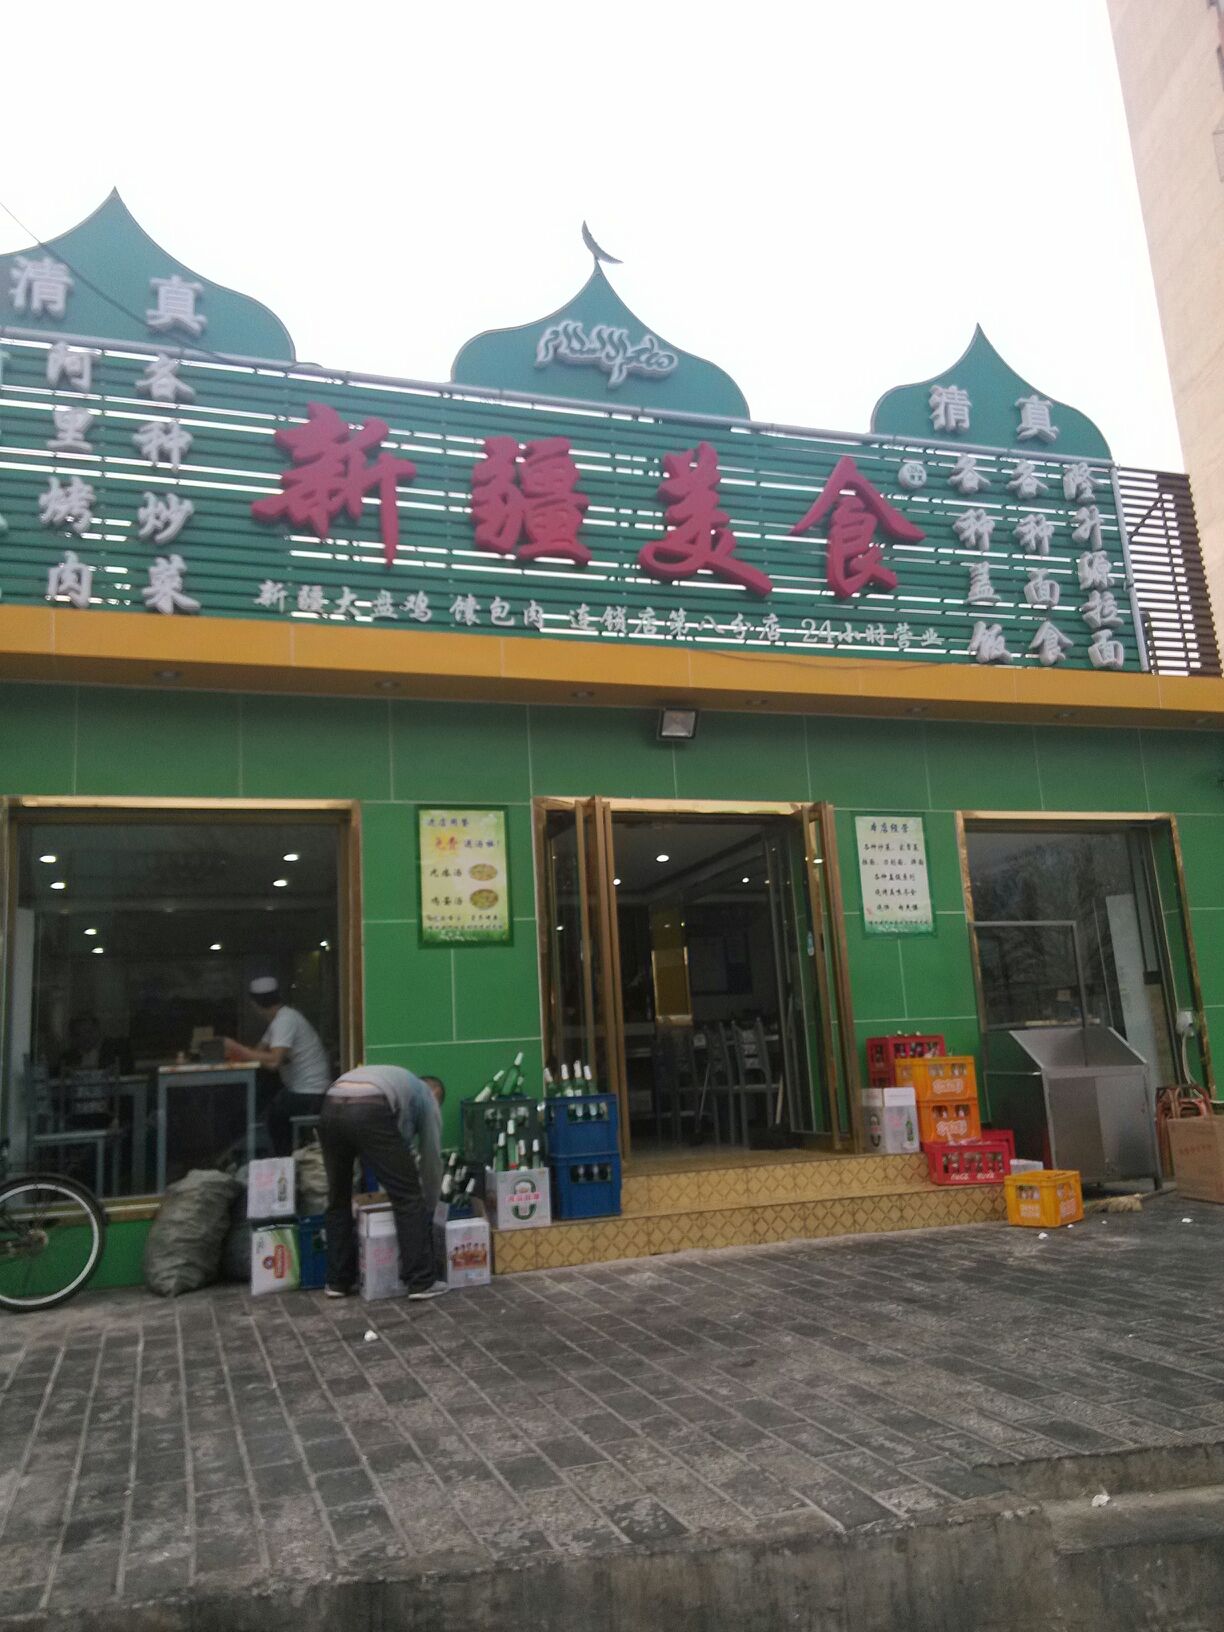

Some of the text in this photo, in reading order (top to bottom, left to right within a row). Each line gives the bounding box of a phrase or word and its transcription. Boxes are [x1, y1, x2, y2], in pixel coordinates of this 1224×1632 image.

[10, 255, 208, 335] 清真
[132, 353, 200, 615] 各种炒菜
[252, 400, 926, 598] 新疆美食
[928, 384, 1060, 443] 清真
[253, 579, 433, 623] 新疆大盘鸡
[800, 617, 943, 650] 24小时营业
[946, 451, 1014, 664] 各种盖饭
[1005, 459, 1074, 666] 各种面食
